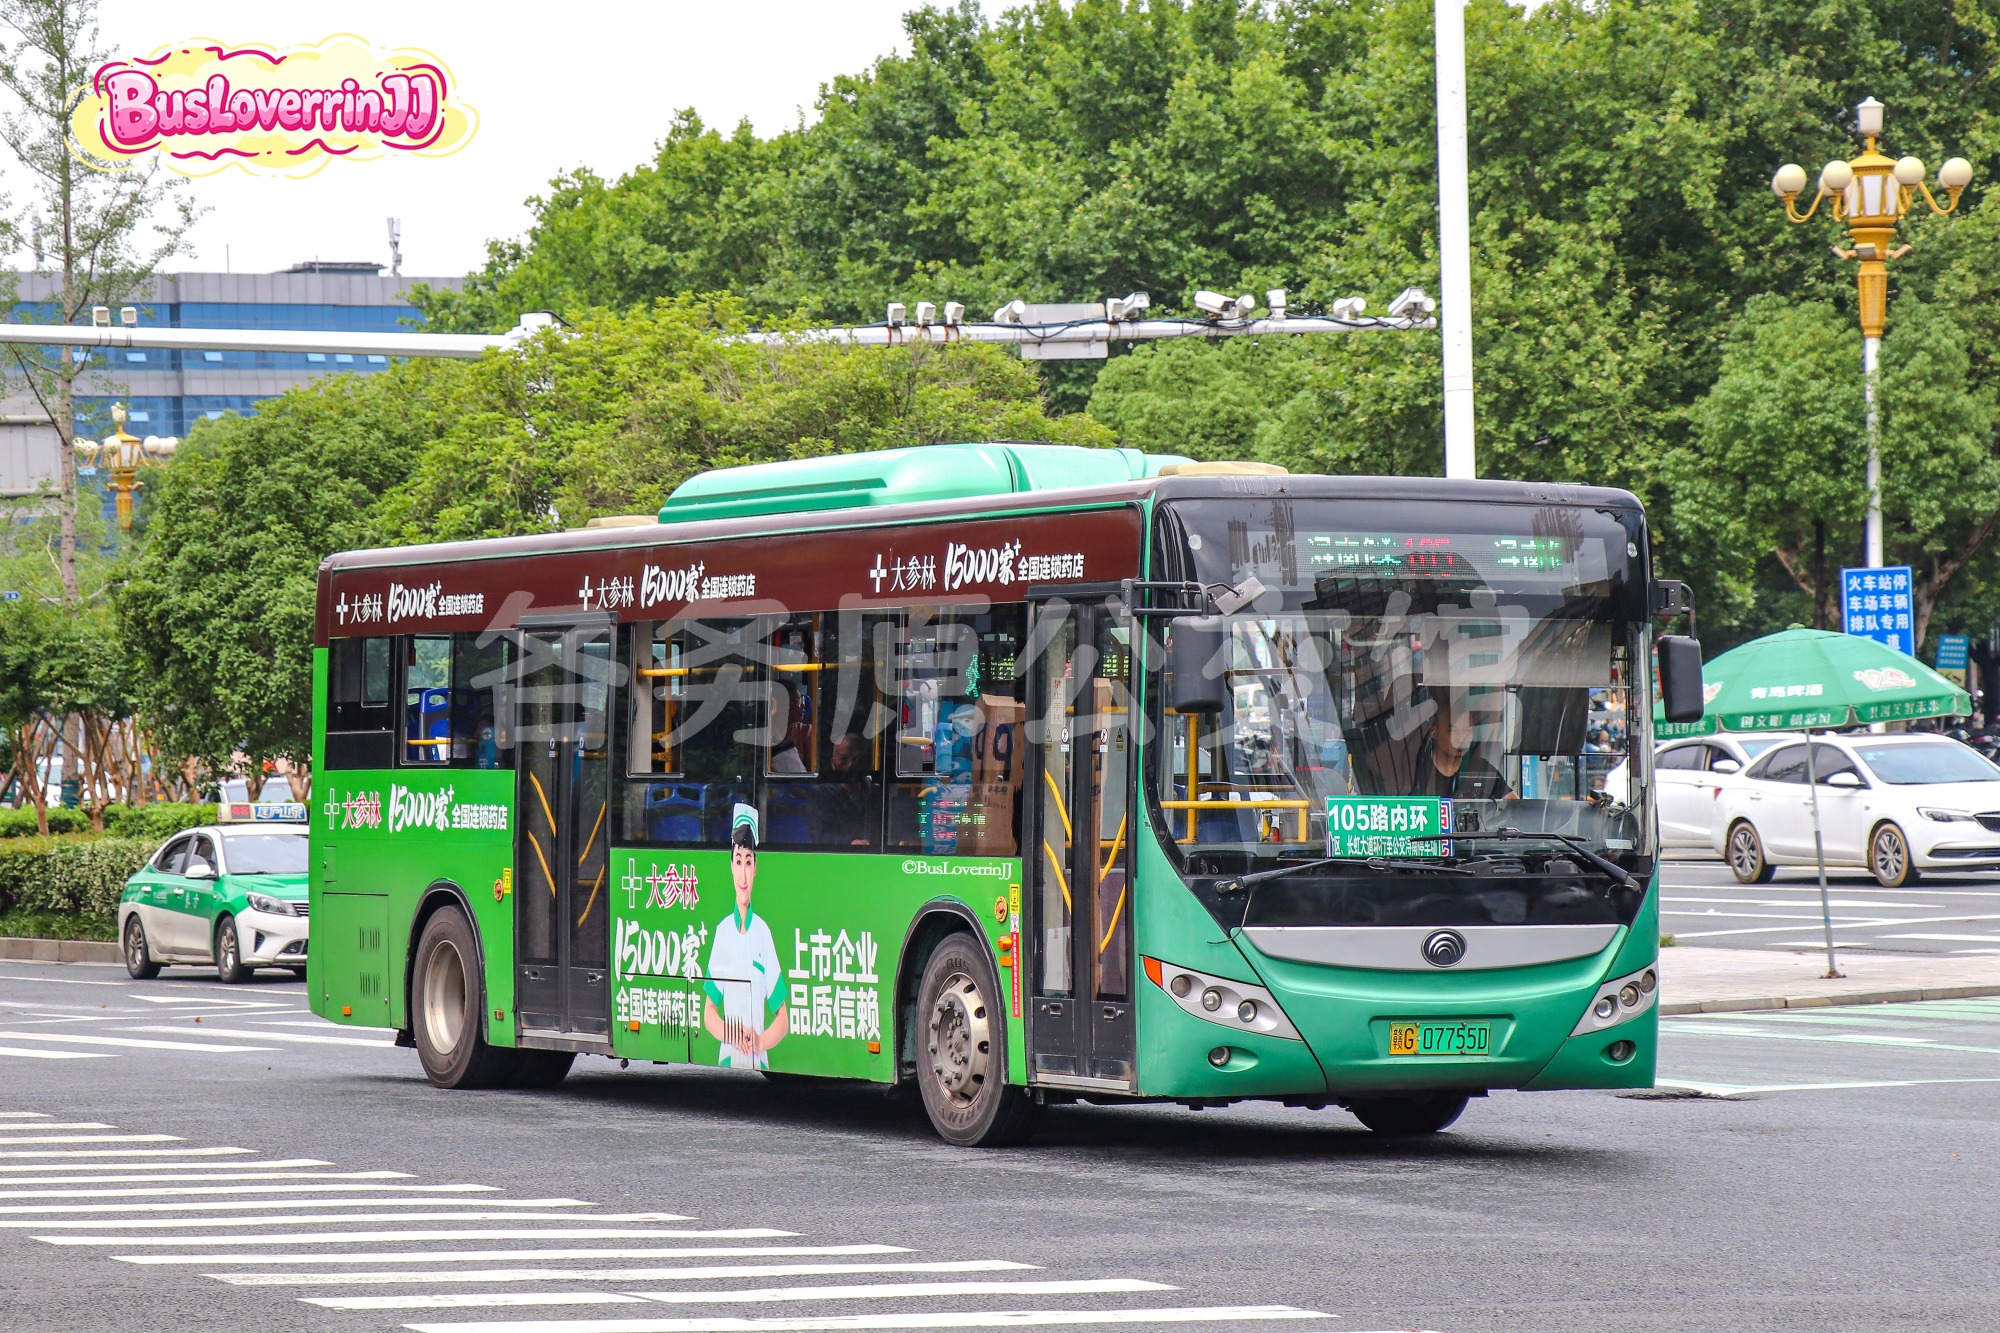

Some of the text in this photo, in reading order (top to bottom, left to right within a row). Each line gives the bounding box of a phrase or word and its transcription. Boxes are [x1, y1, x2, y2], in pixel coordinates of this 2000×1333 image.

[890, 555, 936, 592] 大参林
[1017, 553, 1084, 581] 全国连锁药店
[1848, 574, 1907, 591] 火车站停
[350, 593, 383, 624] 大参林
[438, 592, 484, 616] 全国连锁药店
[596, 576, 634, 610] 大参林
[701, 573, 755, 599] 全国连锁药店
[1849, 593, 1909, 611] 车场车辆
[1850, 614, 1909, 631] 排队专用
[1750, 683, 1824, 699] 青岛啤酒
[341, 791, 382, 829] 大参林
[451, 803, 507, 830] 全国连锁药店
[1328, 804, 1428, 832] 105路内环
[645, 863, 699, 910] 大参林
[788, 928, 879, 984] 上市企业
[616, 985, 700, 1029] 全国连锁药店
[788, 984, 881, 1040] 品质信赖
